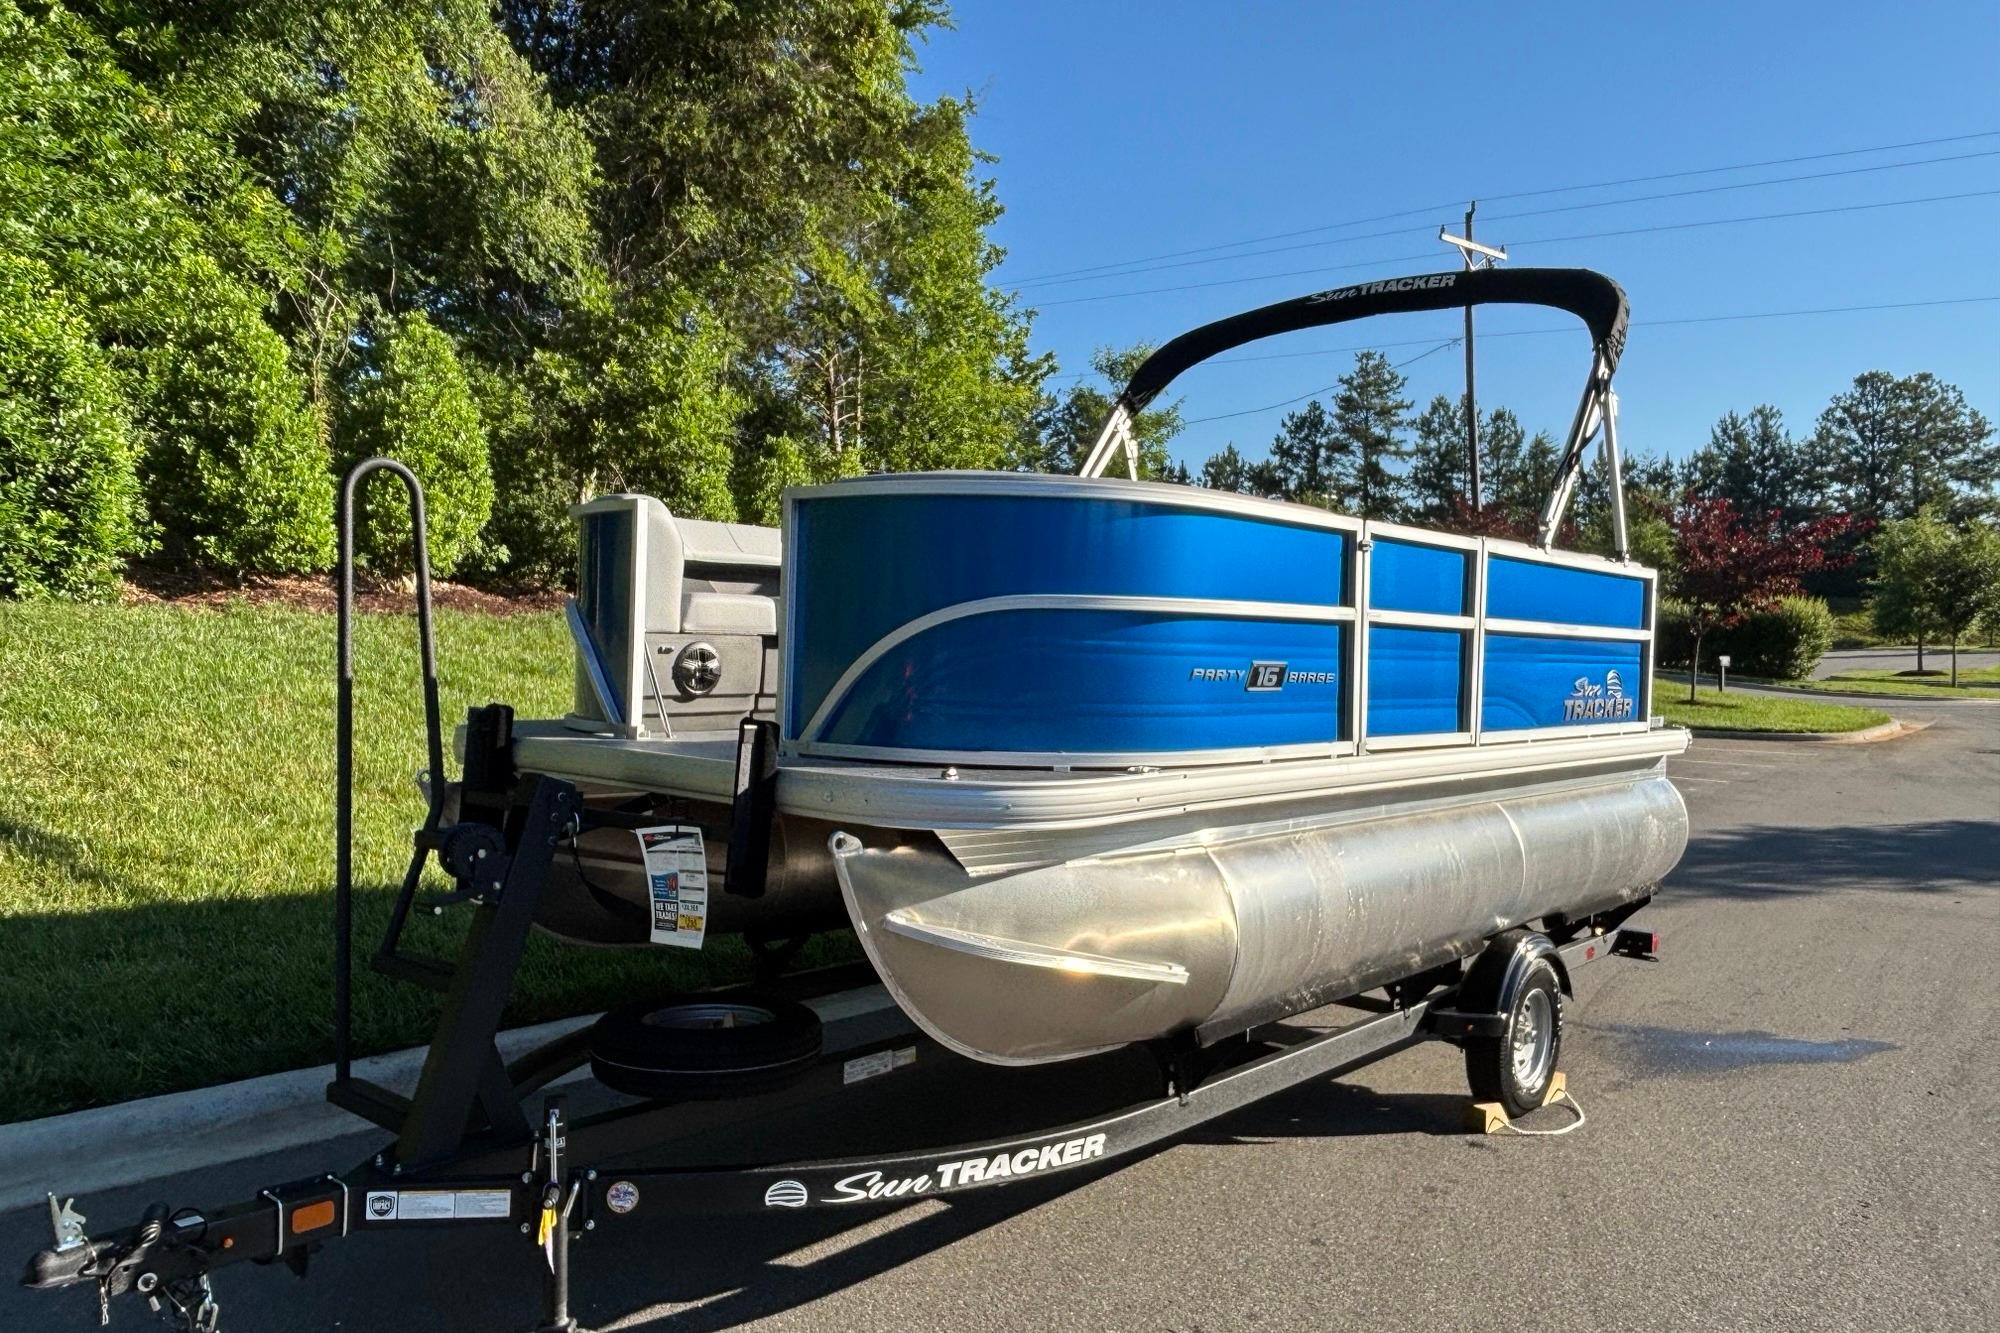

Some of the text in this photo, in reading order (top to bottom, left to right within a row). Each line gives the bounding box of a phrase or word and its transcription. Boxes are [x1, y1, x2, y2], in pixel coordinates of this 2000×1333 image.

[1305, 275, 1456, 305] Sun TRACKER
[1190, 666, 1336, 687] PARTY 16 BARGE
[1571, 676, 1602, 697] Sun
[1563, 698, 1633, 721] TRACKER
[820, 1133, 1107, 1203] Sun TRACKER
